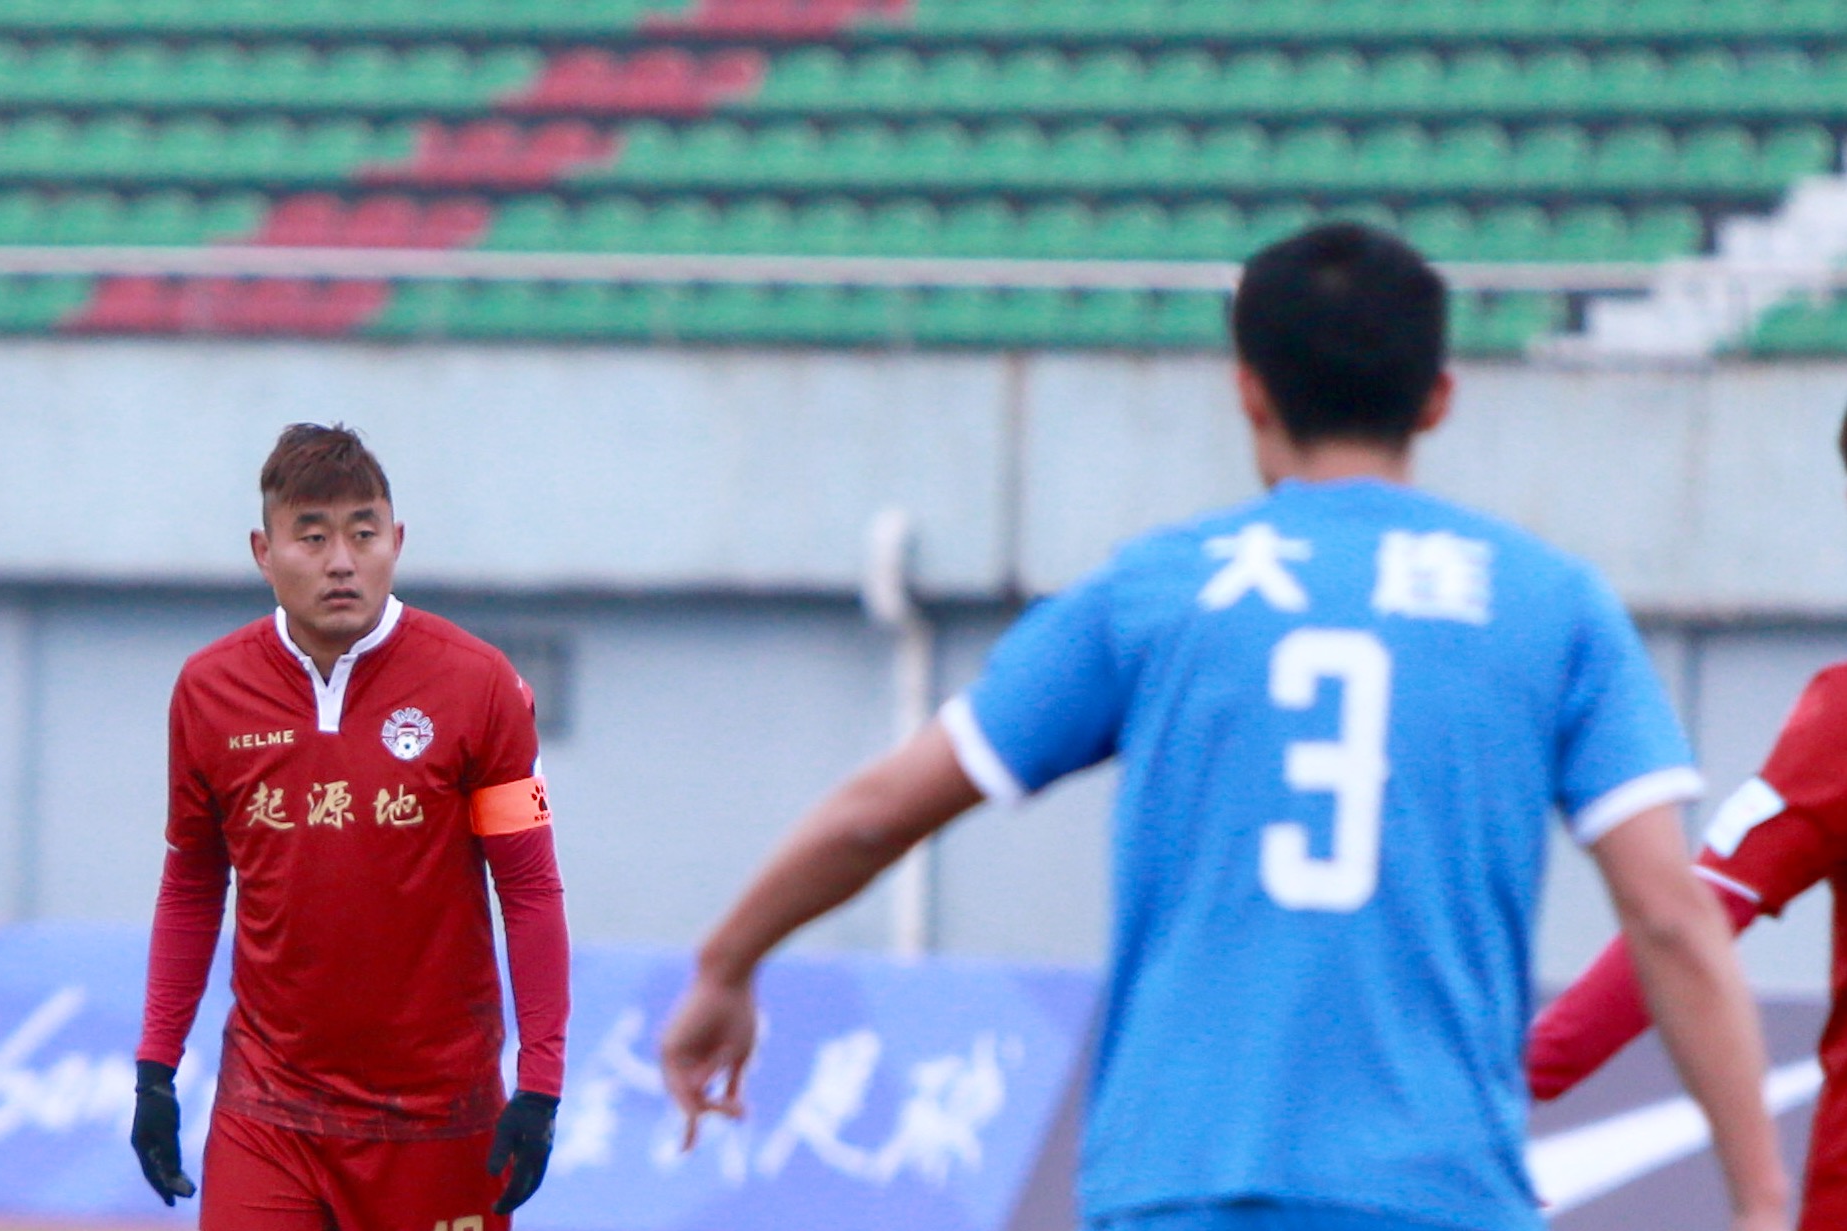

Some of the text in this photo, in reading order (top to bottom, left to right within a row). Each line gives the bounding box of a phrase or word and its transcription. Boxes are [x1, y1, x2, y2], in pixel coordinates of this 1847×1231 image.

[228, 729, 296, 750] KELME
[1259, 626, 1392, 914] 3
[246, 780, 425, 831] 起源地
